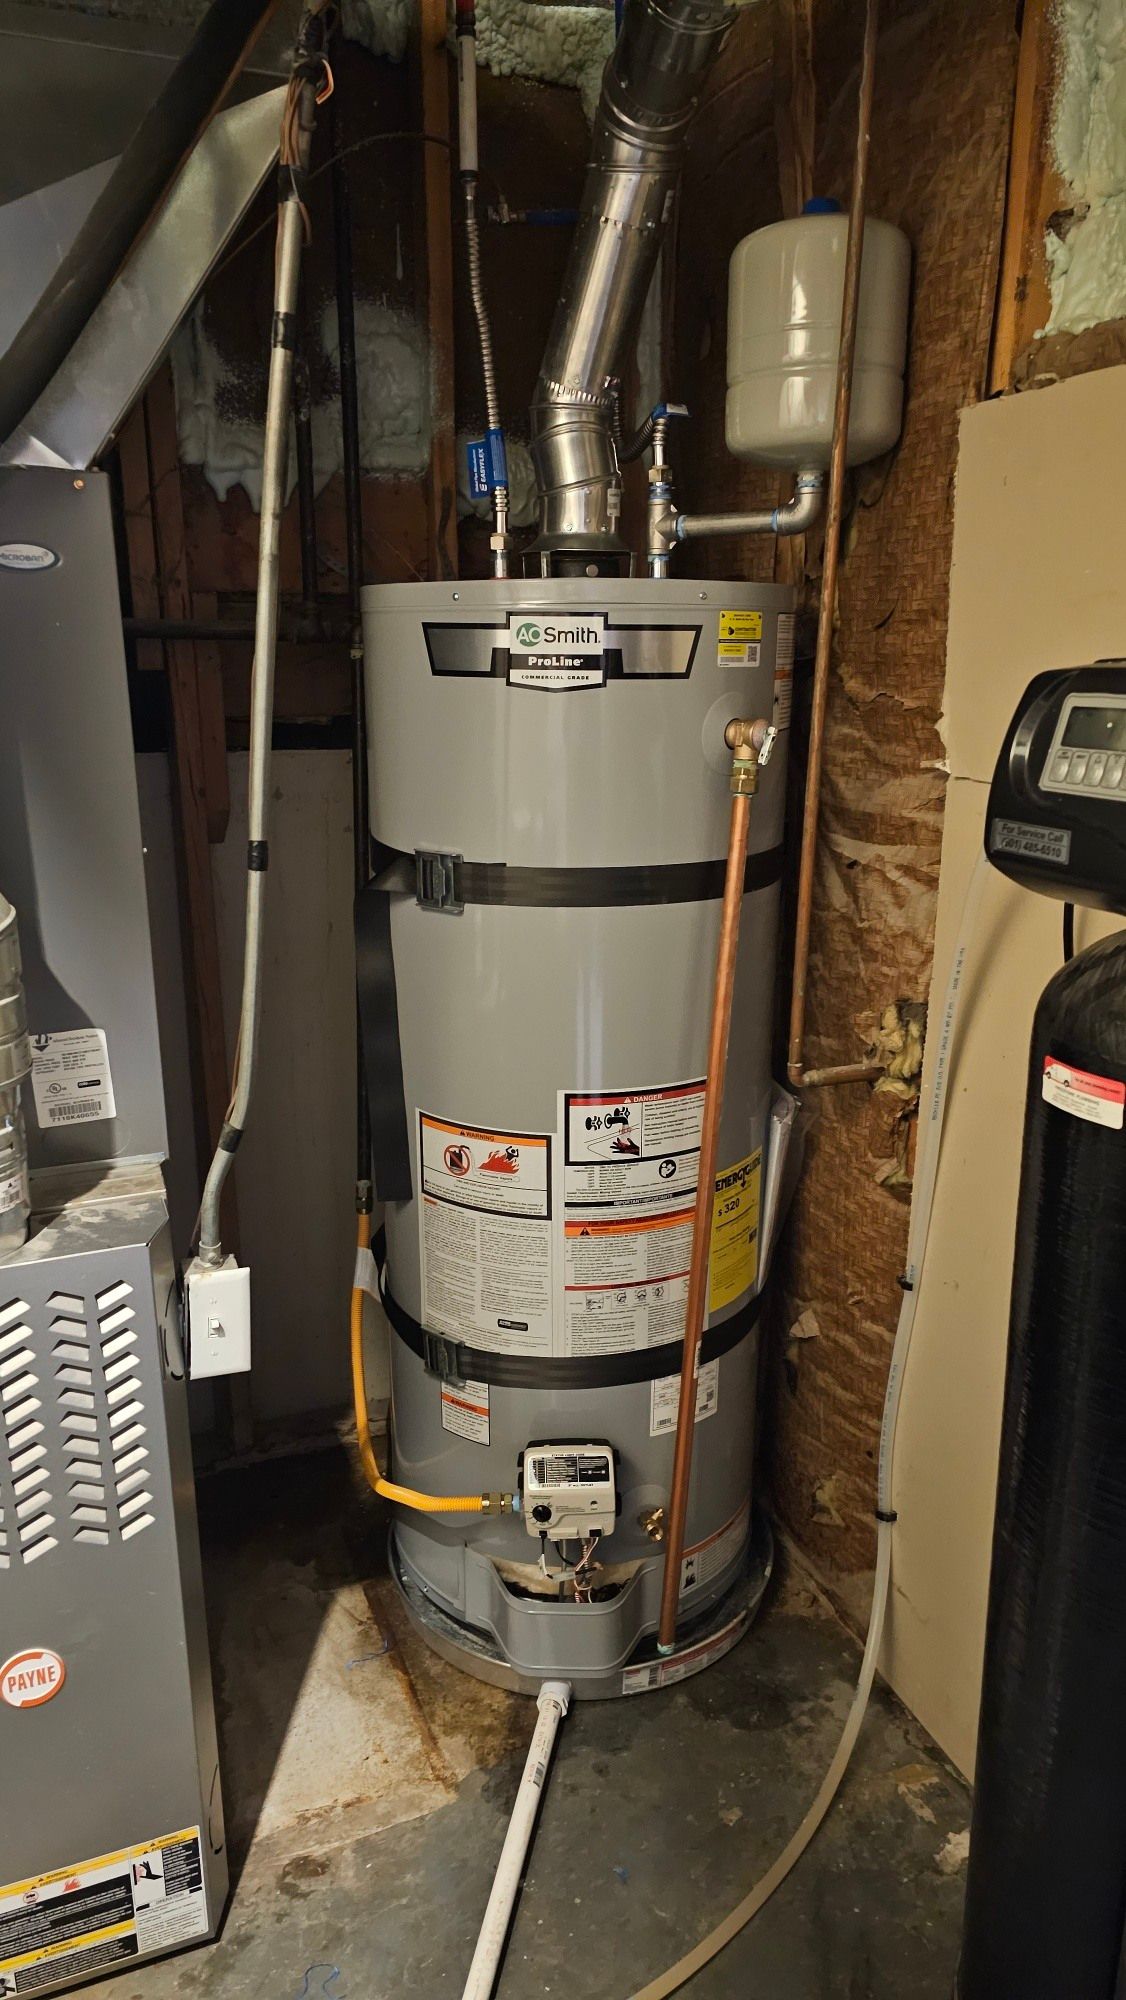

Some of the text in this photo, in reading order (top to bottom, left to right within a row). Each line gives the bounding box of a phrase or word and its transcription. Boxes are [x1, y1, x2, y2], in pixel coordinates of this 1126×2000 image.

[478, 448, 486, 483] EASYFLEX
[543, 626, 598, 643] Smith
[528, 656, 581, 667] ProLine
[1002, 823, 1065, 843] For Service Call
[633, 1093, 663, 1103] DANGER
[465, 1132, 495, 1142] WARNING
[7, 1665, 56, 1693] PAYNE
